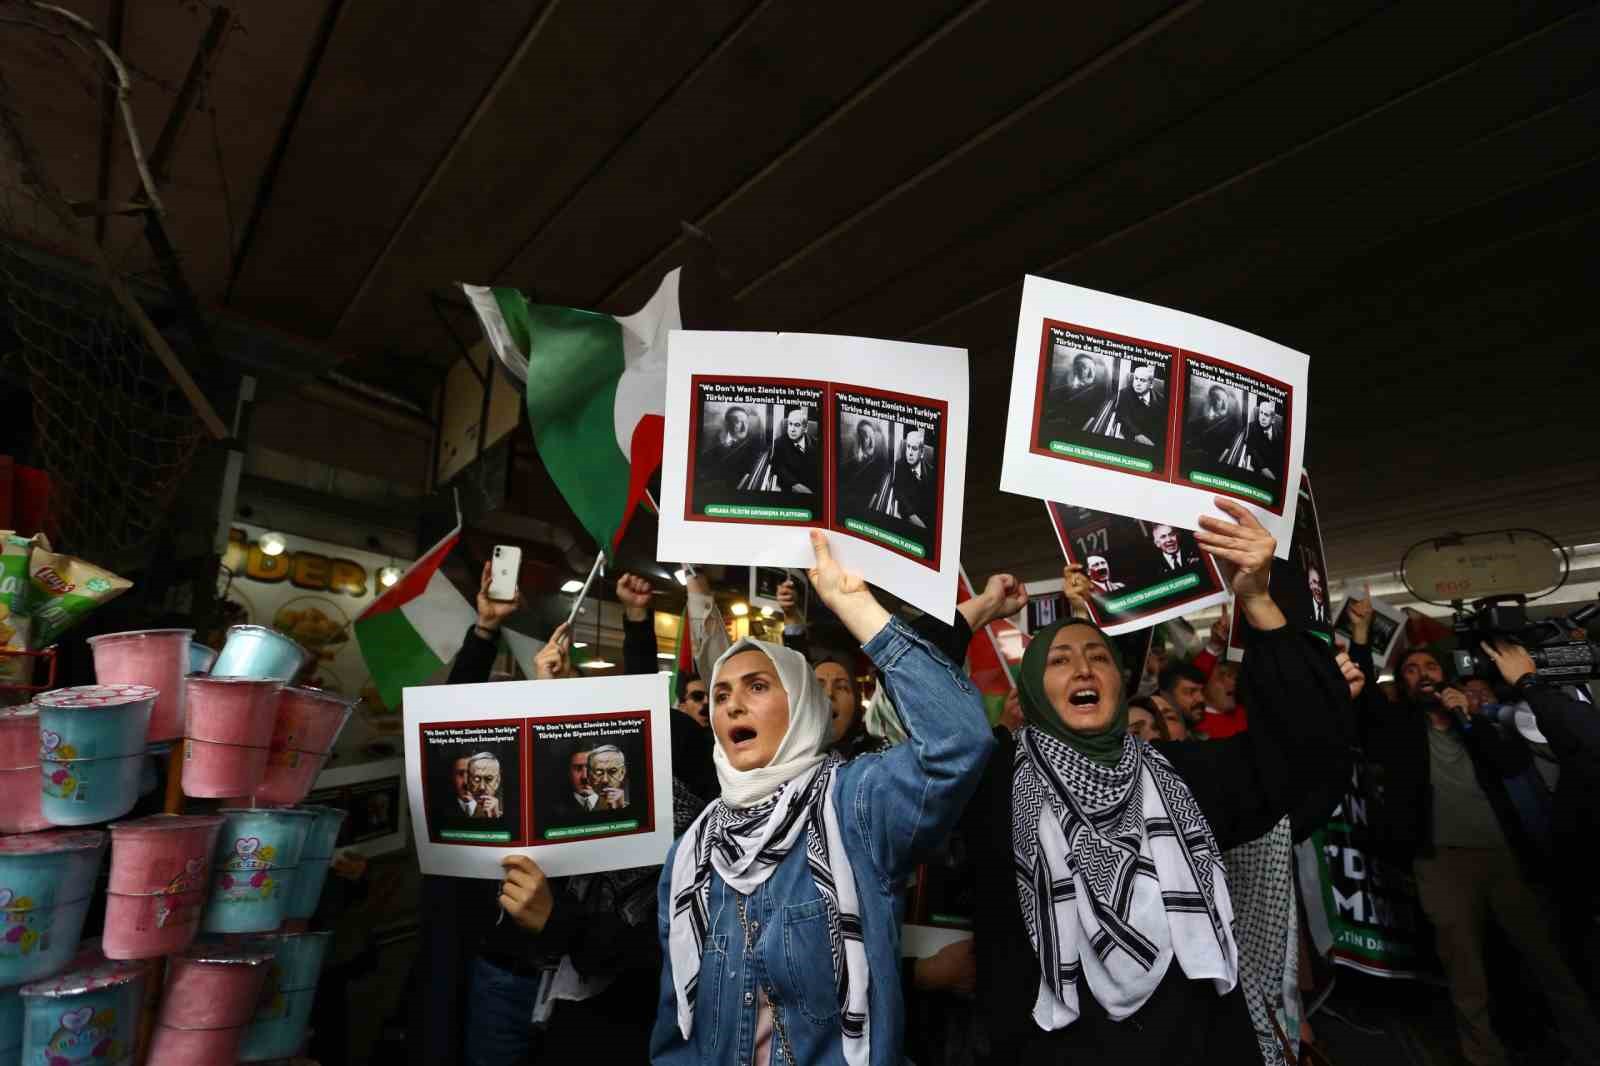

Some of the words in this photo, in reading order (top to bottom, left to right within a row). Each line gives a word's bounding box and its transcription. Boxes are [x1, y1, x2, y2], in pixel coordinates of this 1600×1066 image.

[1086, 335, 1105, 345] Want
[715, 384, 735, 393] Don't
[736, 385, 756, 393] Want
[865, 397, 881, 407] Want
